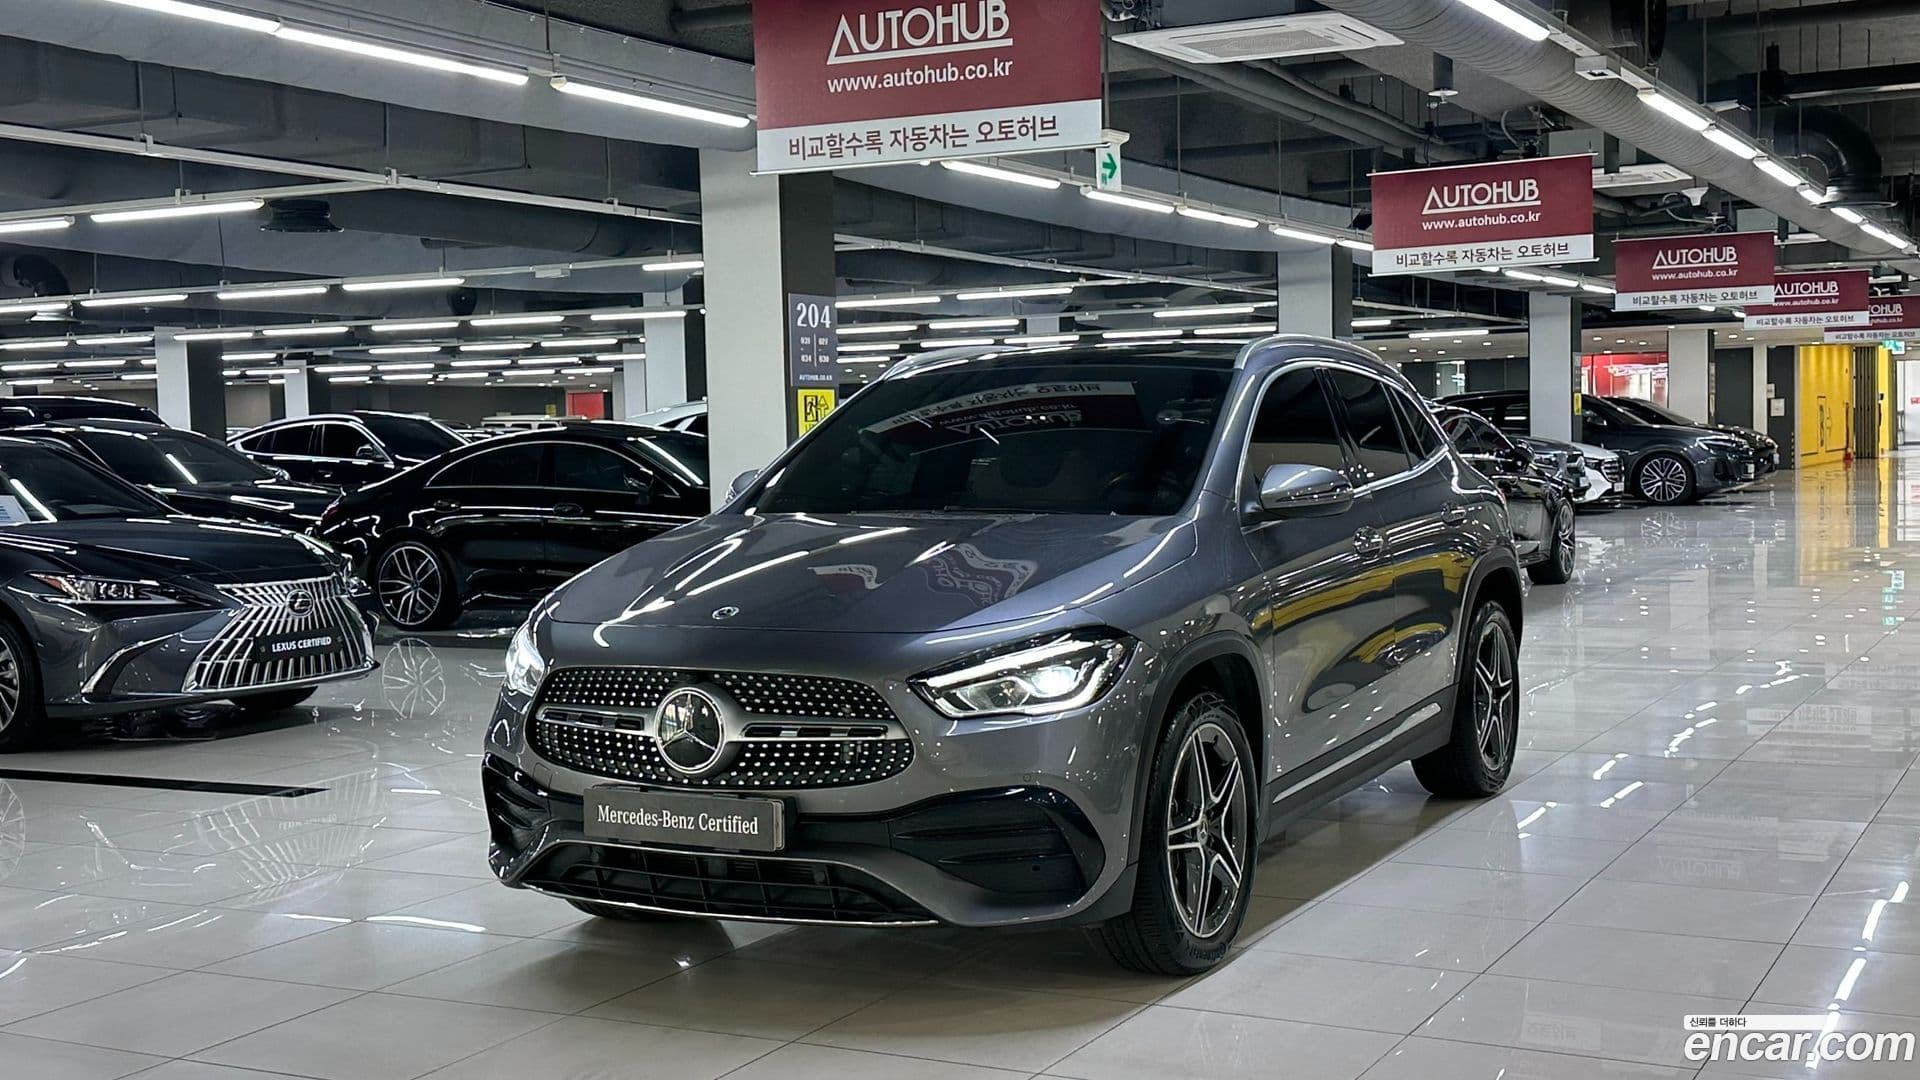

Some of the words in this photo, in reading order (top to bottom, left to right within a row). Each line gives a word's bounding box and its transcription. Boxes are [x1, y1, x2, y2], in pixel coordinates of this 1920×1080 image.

[827, 0, 1013, 65] AUTOHUB
[827, 58, 1013, 93] www.autohub.co.kr
[789, 130, 883, 161] 비교할수록
[889, 123, 969, 153] 자동차는
[975, 115, 1059, 143] 오토허브
[1421, 178, 1541, 215] AUTOHUB
[1422, 211, 1541, 231] www.autohub.co.kr
[1396, 250, 1458, 267] 비교할수록
[1462, 246, 1513, 265] 자동차는
[1517, 242, 1570, 259] 오토허브
[1652, 246, 1738, 269] AUTOHUB
[1652, 268, 1738, 281] www.autohub.co.kr
[1774, 281, 1839, 297] AUTOHUB
[796, 302, 832, 328] 204
[272, 641, 297, 653] LEXUS
[297, 636, 332, 649] CERTIFIED
[597, 805, 695, 830] Mercedes-Benz
[698, 812, 759, 835] Certified
